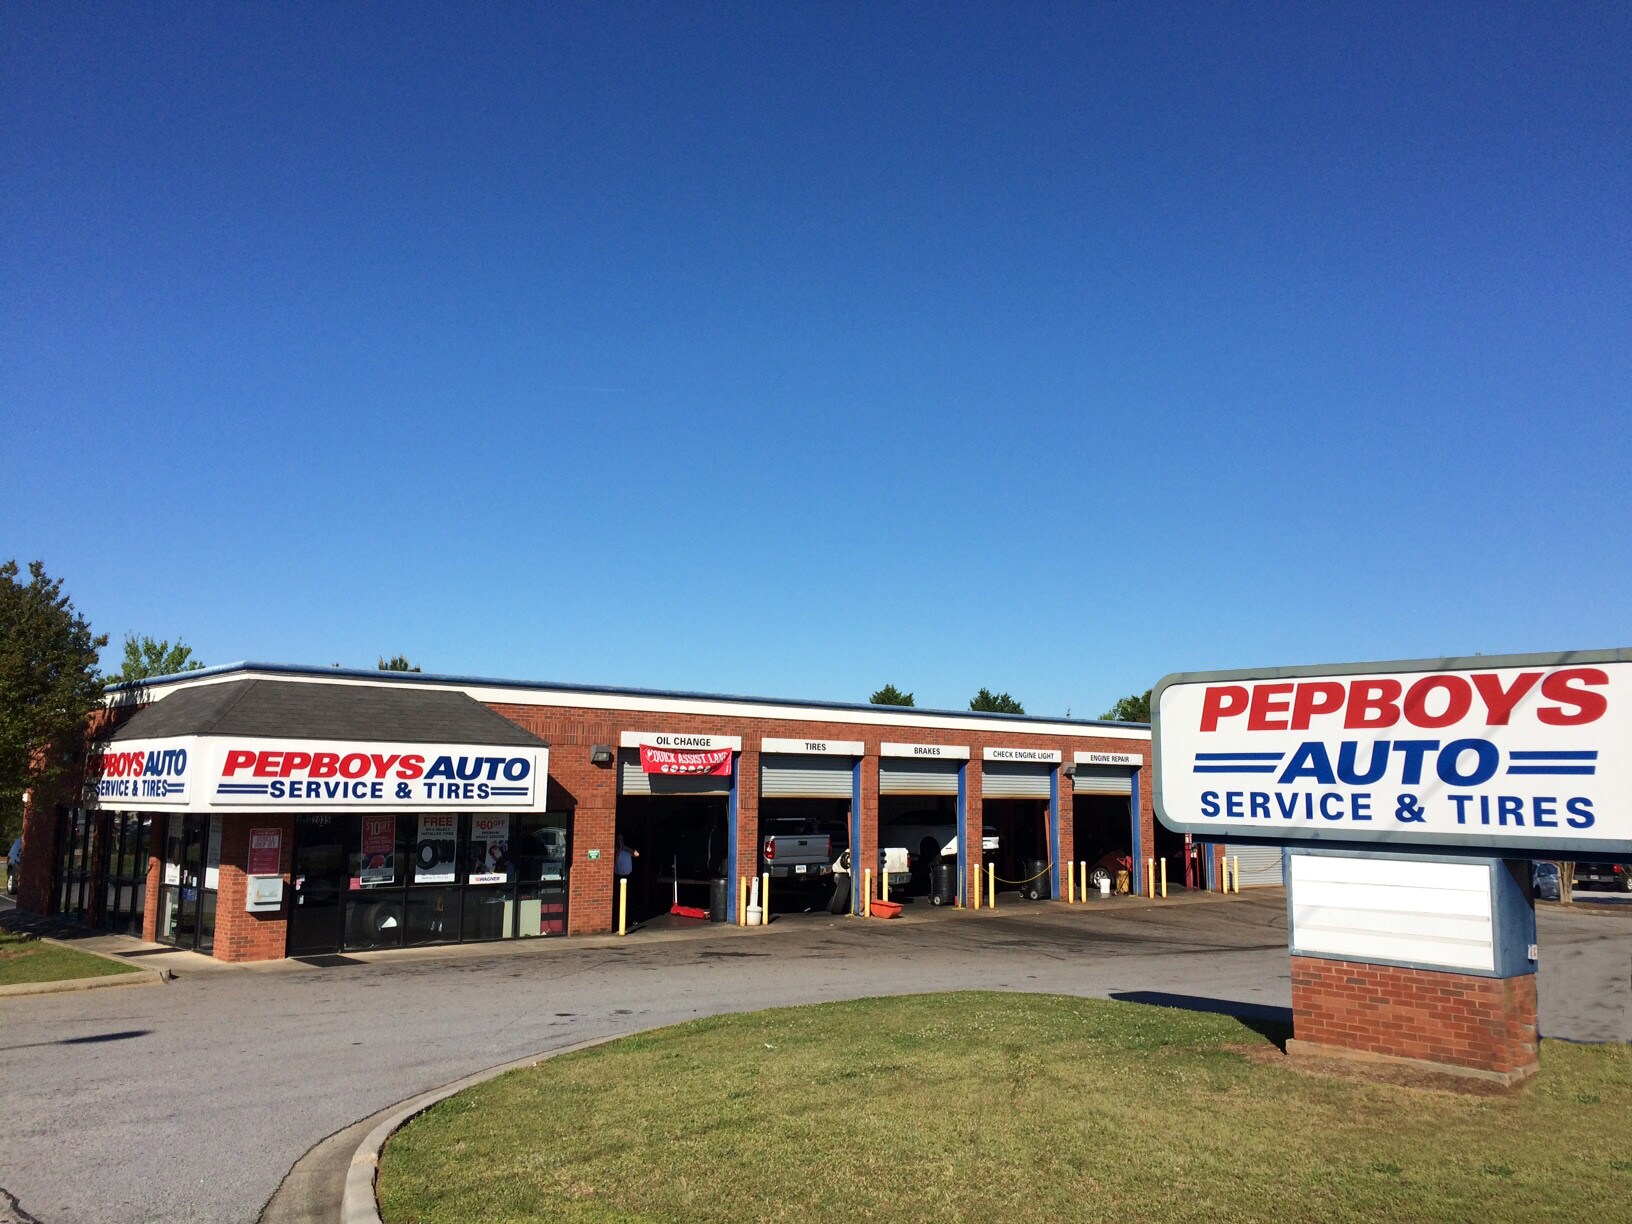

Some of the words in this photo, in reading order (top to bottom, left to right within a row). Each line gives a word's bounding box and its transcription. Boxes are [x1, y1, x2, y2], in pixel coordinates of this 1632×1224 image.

[1199, 668, 1610, 733] PEPBOYS
[656, 736, 672, 746] OIL
[673, 737, 711, 747] CHANGE
[805, 742, 827, 751] TIRES
[653, 750, 677, 763] QUICK
[678, 753, 706, 764] ASSIST
[914, 746, 941, 756] BRAKES
[993, 750, 1013, 759] CHECK
[1014, 751, 1036, 760] ENGINE
[1037, 751, 1055, 760] LIGHT
[1090, 754, 1110, 762] ENGINE
[1111, 755, 1130, 763] REPAIR
[86, 751, 146, 779] PBOYS
[144, 748, 187, 776] AUTO
[222, 749, 426, 781] PEPBOYS
[423, 755, 530, 782] AUTO
[1278, 738, 1500, 787] AUTO
[132, 780, 138, 796] &
[142, 780, 169, 797] TIRES
[270, 780, 383, 799] SERVICE
[396, 782, 413, 799] &
[423, 783, 490, 800] TIRES
[1201, 790, 1373, 821] SERVICE
[1394, 793, 1426, 823] &
[1447, 794, 1596, 829] TIRES
[423, 816, 453, 826] FREE
